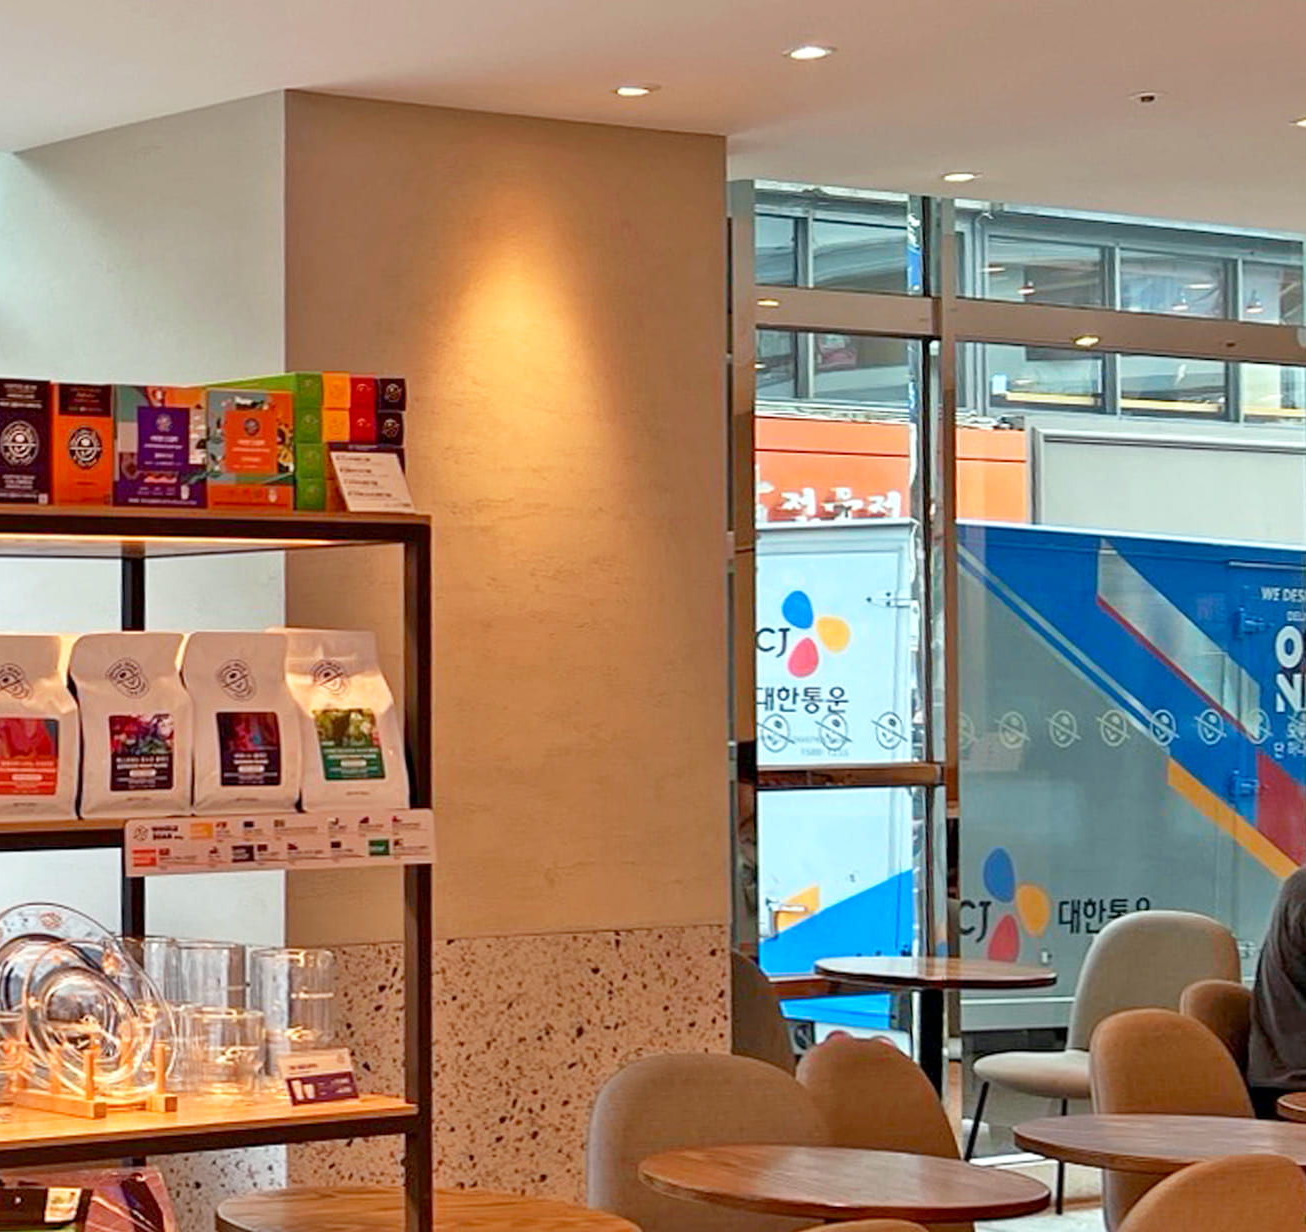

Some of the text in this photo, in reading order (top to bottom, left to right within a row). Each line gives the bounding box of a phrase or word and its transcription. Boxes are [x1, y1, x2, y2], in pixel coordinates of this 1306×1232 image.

[755, 626, 791, 658] CJ
[756, 685, 850, 715] 대한통운
[959, 900, 992, 943] CJ
